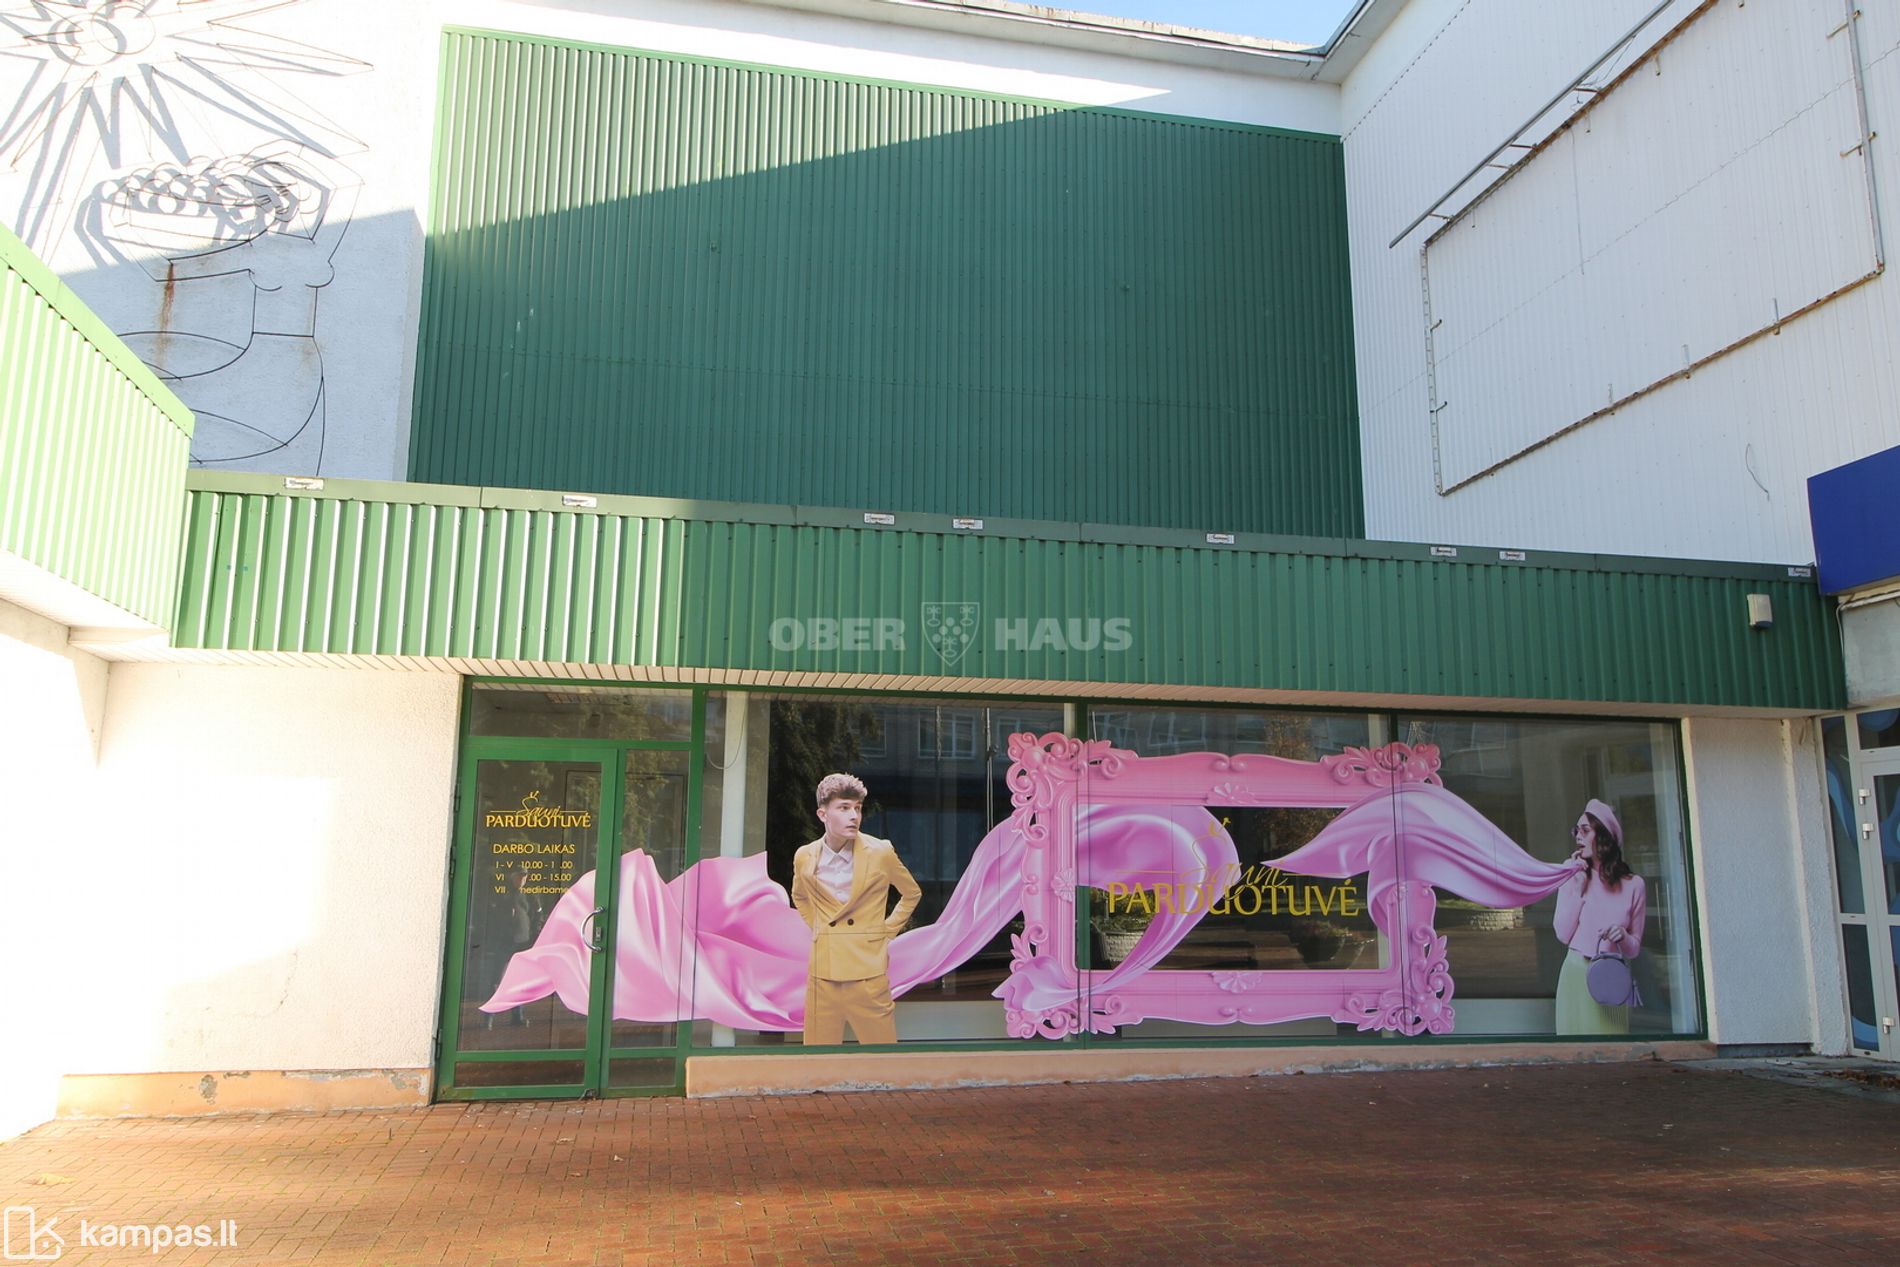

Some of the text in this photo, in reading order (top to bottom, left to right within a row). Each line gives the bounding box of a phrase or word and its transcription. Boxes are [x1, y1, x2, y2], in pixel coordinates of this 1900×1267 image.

[486, 812, 592, 828] PARDUOTUVĖ
[493, 843, 575, 854] DARBO LAIKAS
[1107, 880, 1360, 917] PARDUOTUVĖ
